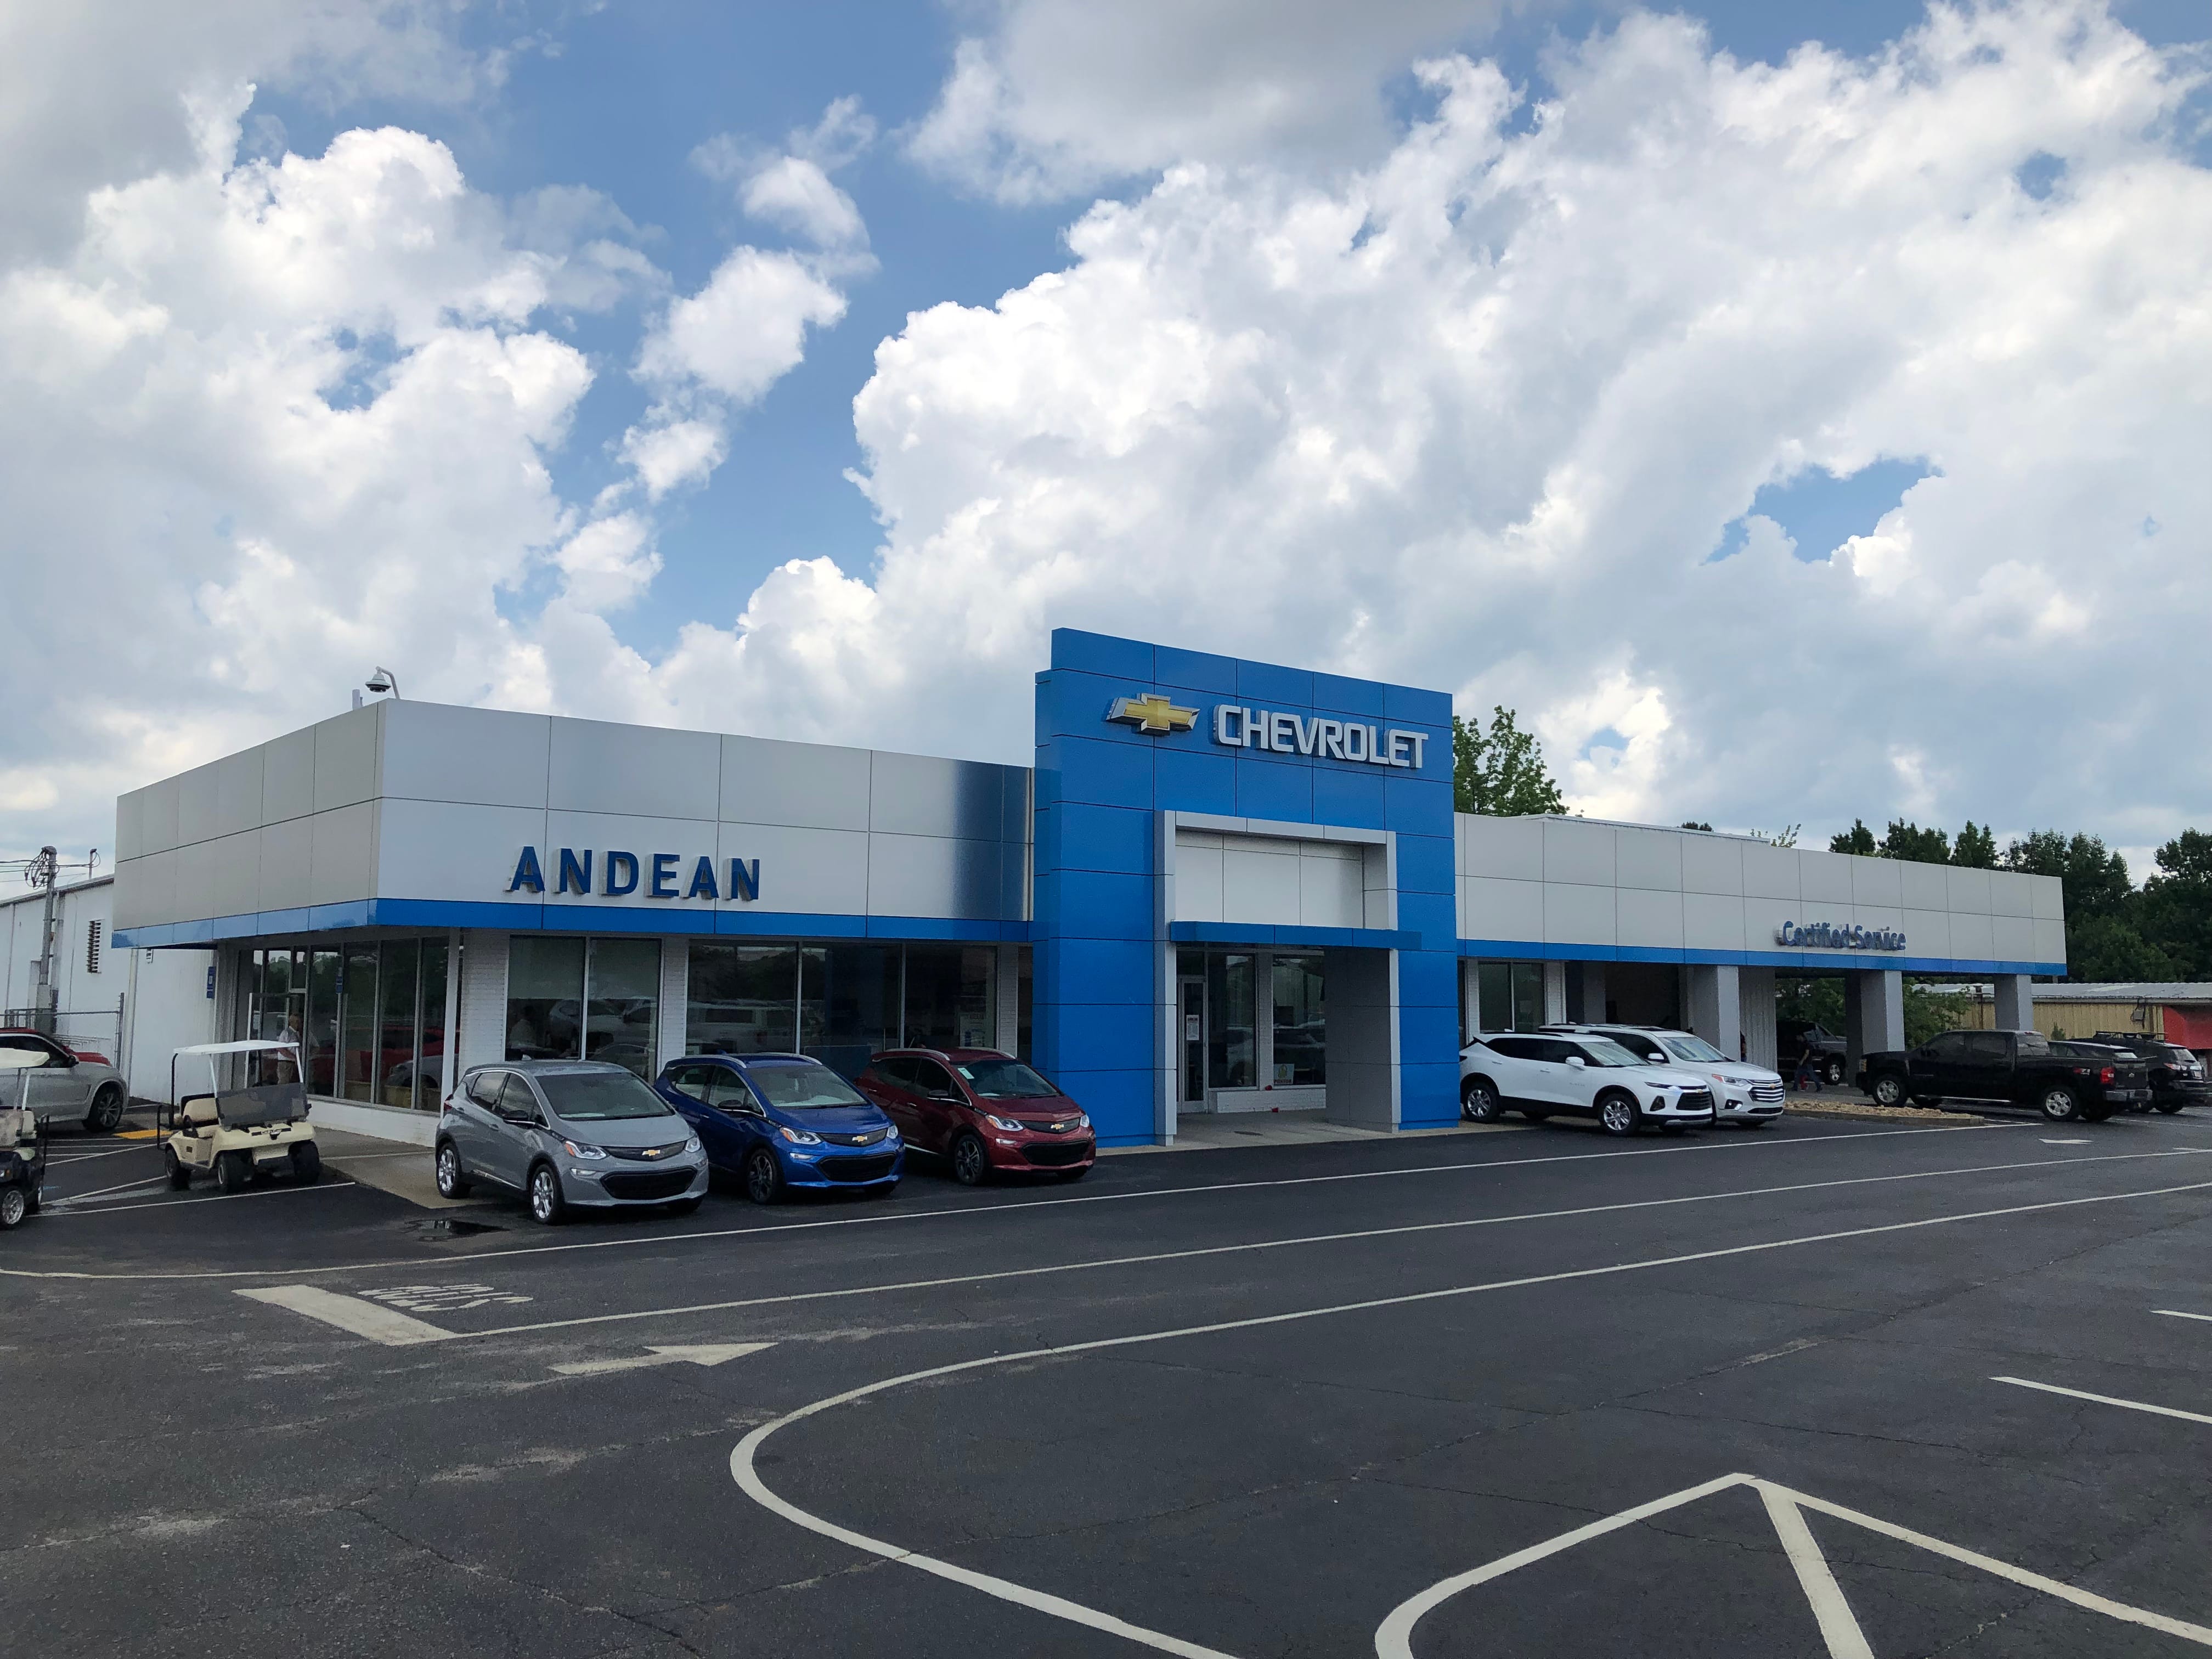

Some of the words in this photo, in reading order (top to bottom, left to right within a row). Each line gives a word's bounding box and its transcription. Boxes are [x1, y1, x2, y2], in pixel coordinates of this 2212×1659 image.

[1215, 704, 1429, 768] CHEVROLET
[510, 845, 760, 900] ANDEAN
[1782, 921, 1850, 949] Certified
[1854, 925, 1906, 950] Service
